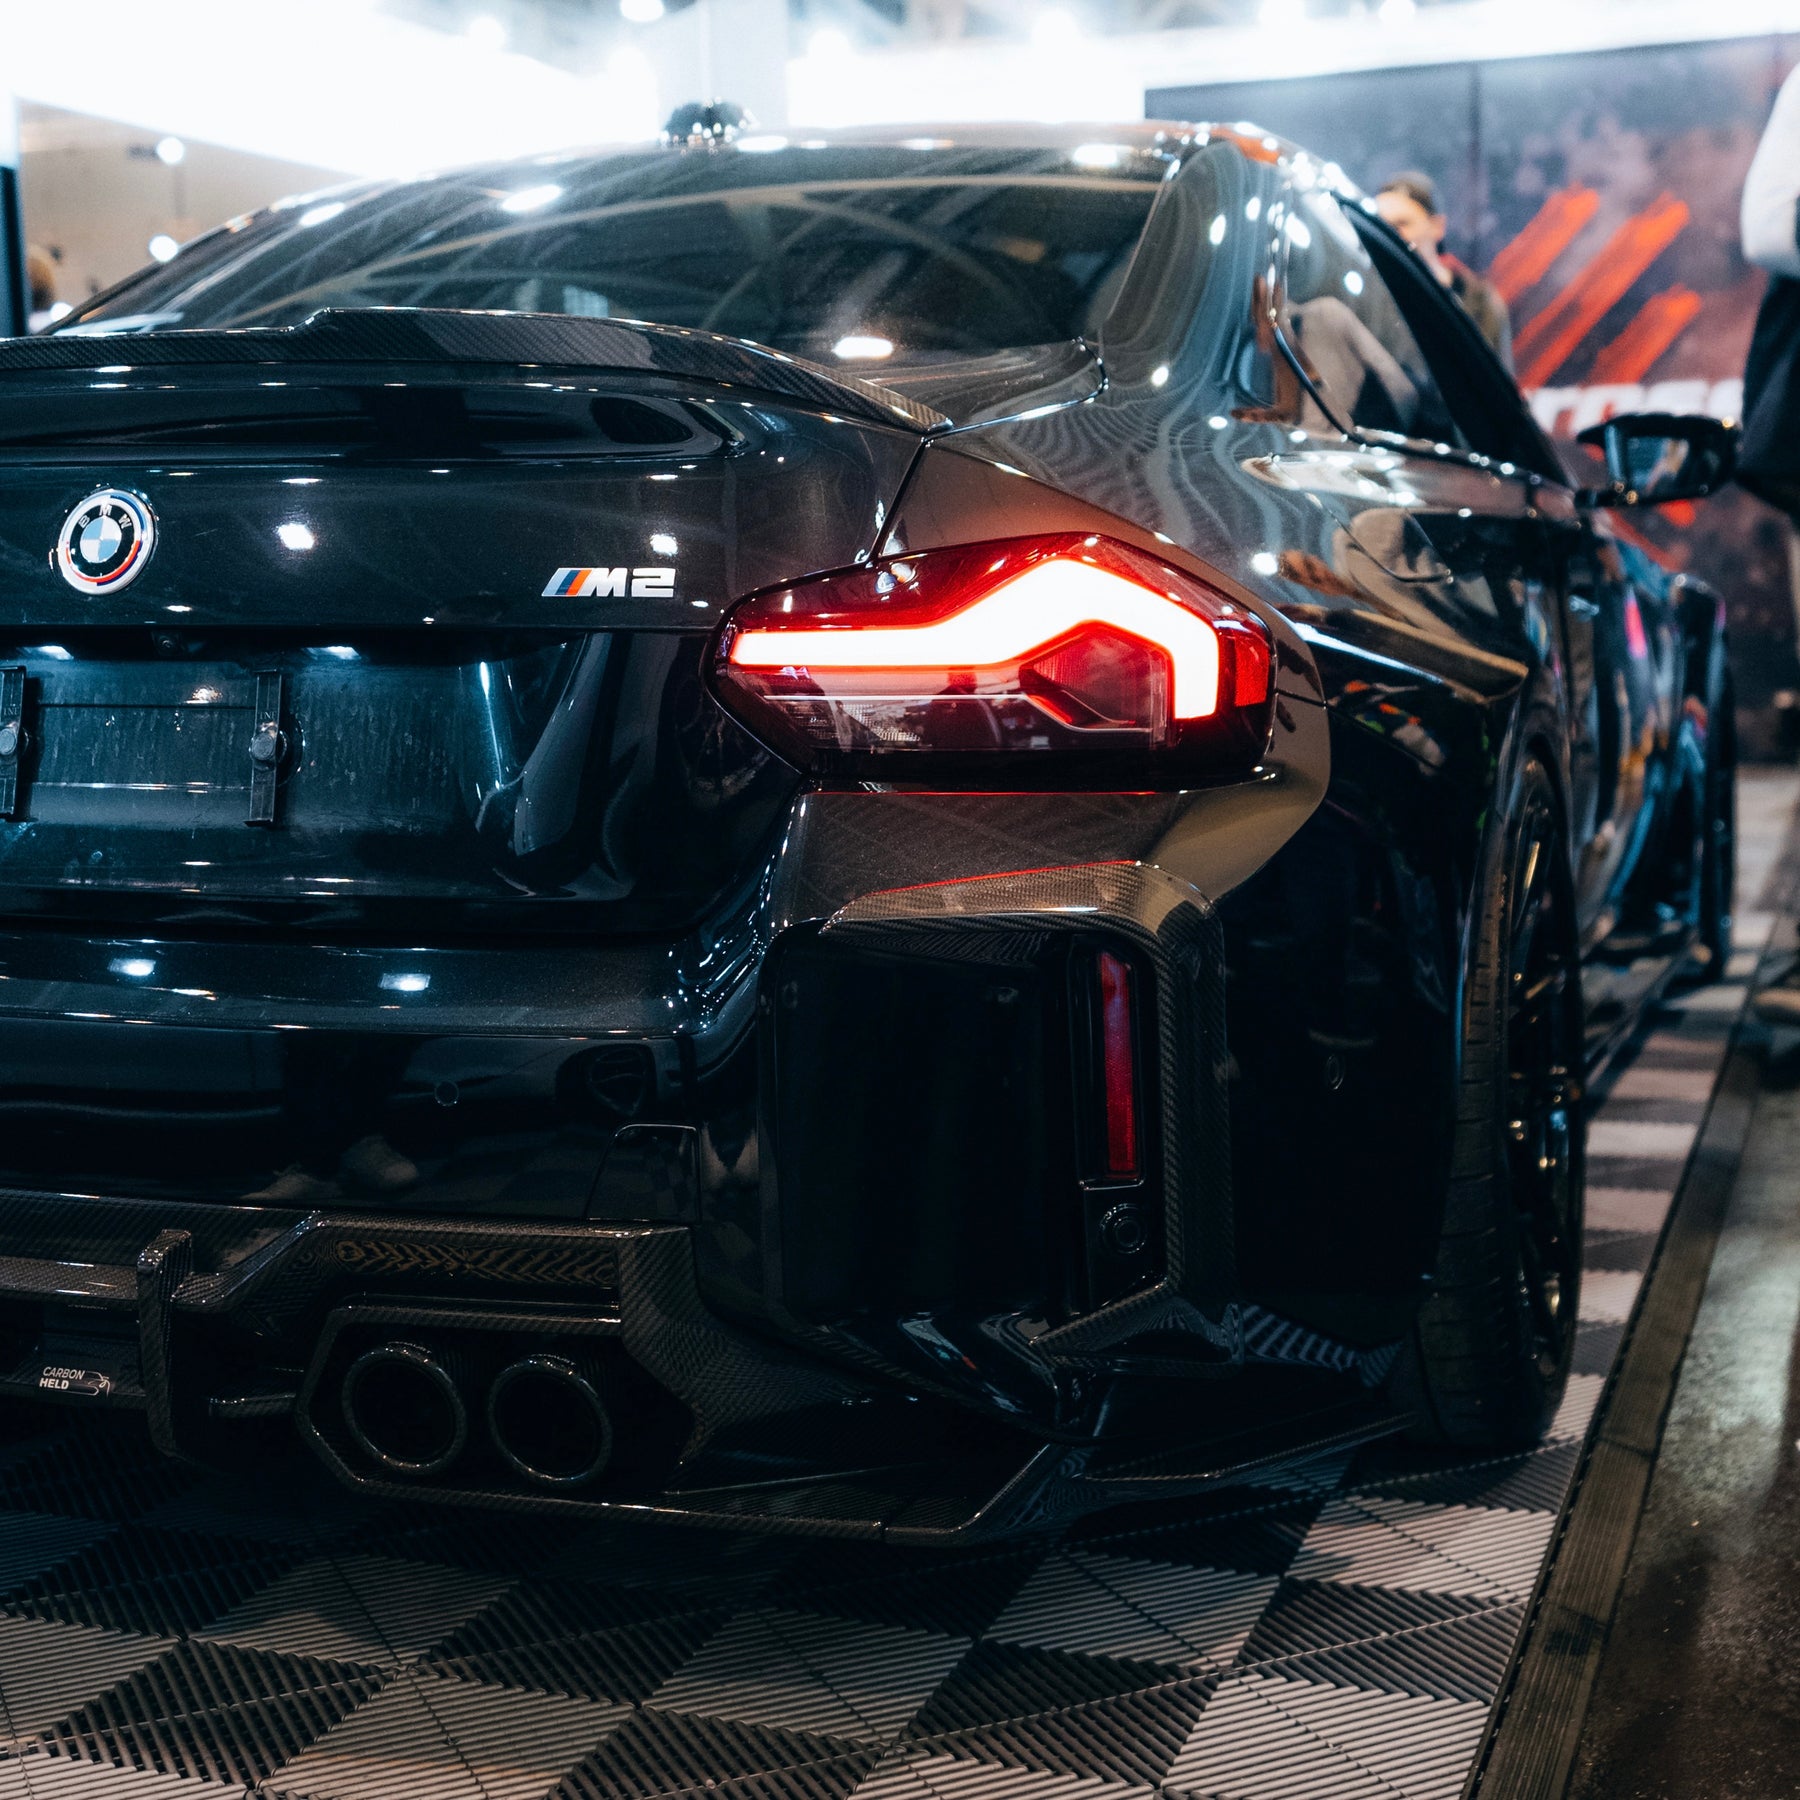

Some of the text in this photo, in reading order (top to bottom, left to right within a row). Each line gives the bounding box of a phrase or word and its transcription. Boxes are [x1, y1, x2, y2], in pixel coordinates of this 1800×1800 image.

[78, 503, 132, 529] BMW
[574, 567, 676, 597] M2
[43, 1366, 85, 1380] CARBON
[39, 1377, 70, 1390] HELD
